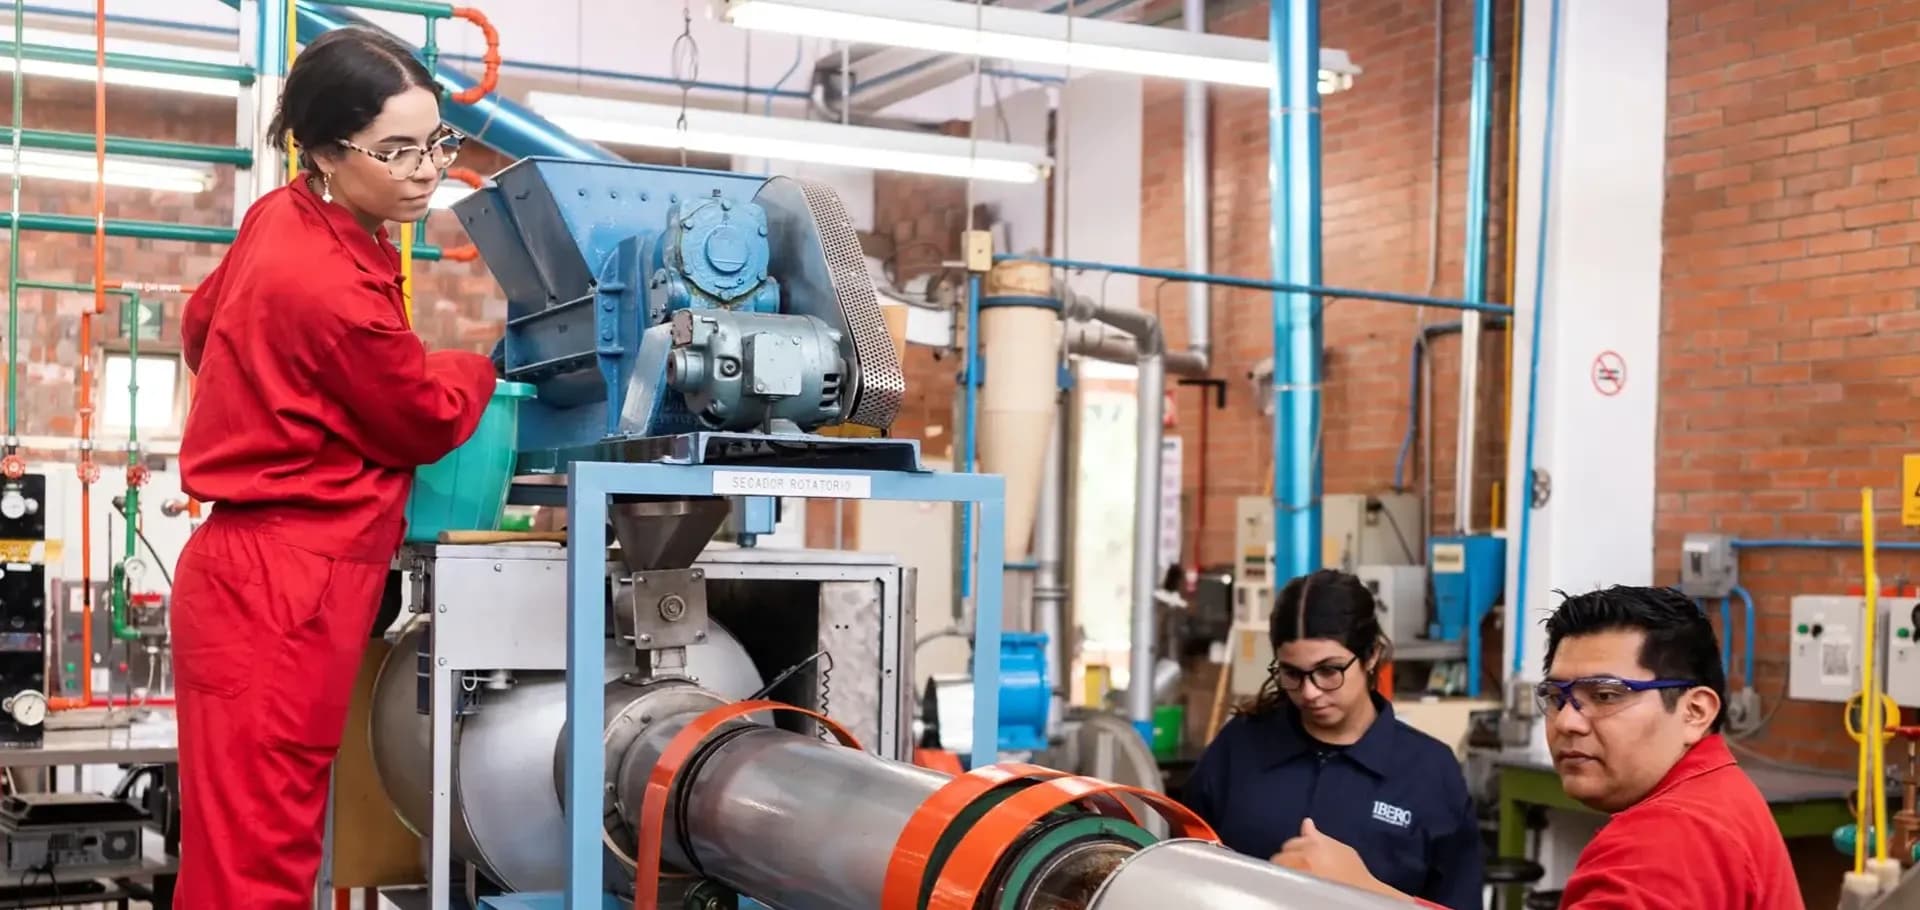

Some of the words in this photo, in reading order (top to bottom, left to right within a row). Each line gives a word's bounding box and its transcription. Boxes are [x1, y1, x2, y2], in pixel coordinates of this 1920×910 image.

[732, 476, 784, 489] SECADOR
[790, 478, 850, 492] ROTATORIO
[1373, 801, 1411, 825] IBERO
